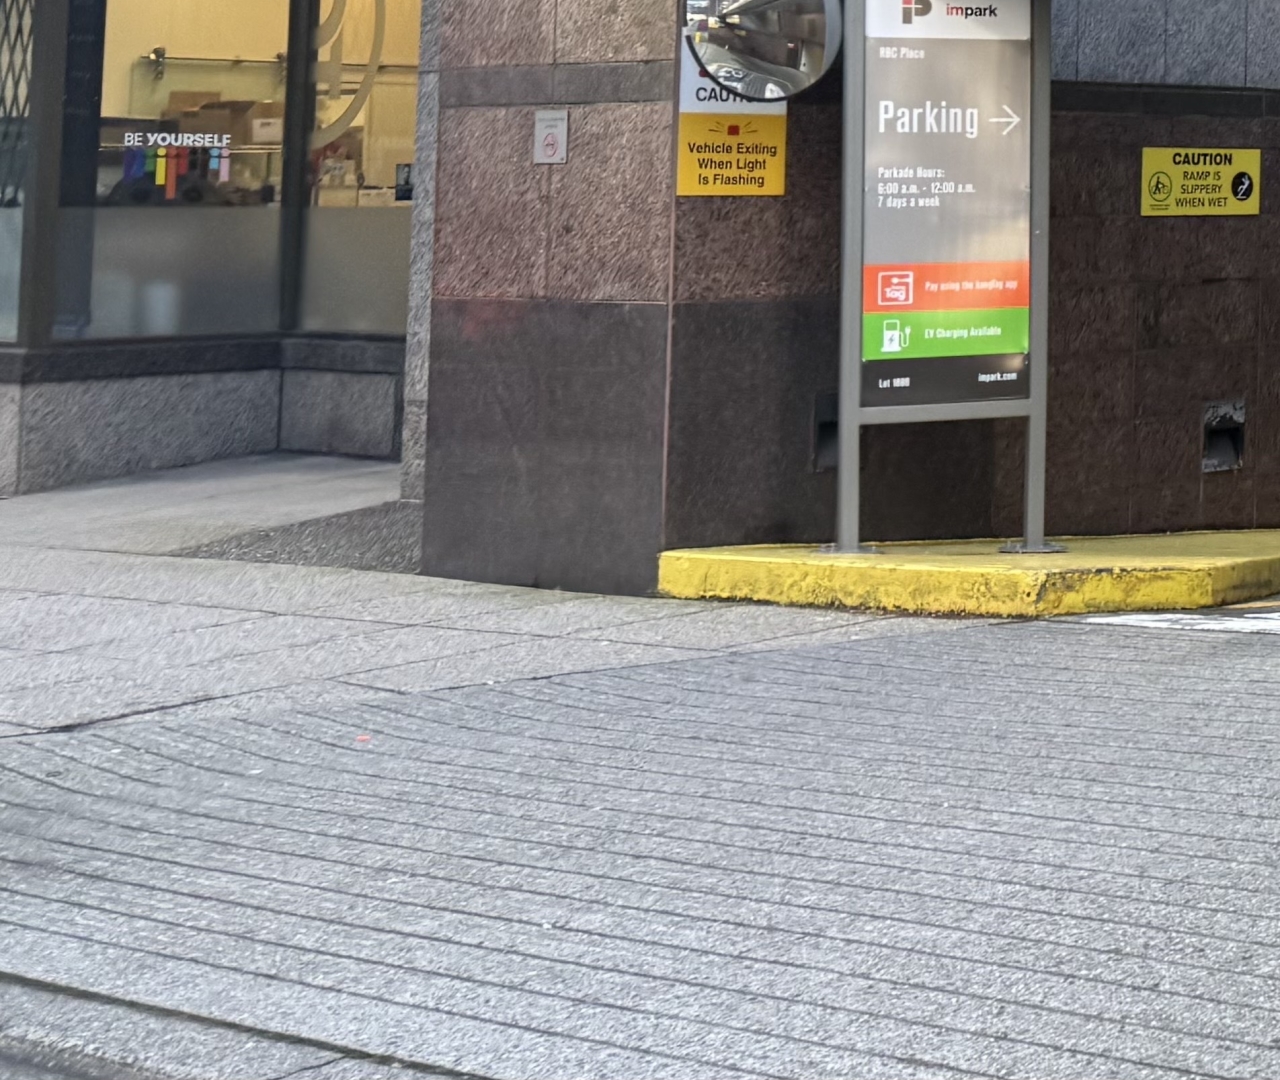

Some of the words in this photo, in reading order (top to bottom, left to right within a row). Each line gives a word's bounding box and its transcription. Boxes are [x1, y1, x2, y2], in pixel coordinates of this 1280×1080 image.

[946, 3, 997, 19] impark
[879, 47, 897, 59] RBC
[900, 47, 925, 59] Place
[878, 100, 979, 138] Parking
[124, 132, 143, 146] BE
[146, 132, 231, 146] YOURSELF
[688, 142, 732, 153] Vehicle
[737, 142, 777, 157] Exiting
[698, 158, 732, 170] When
[737, 158, 766, 172] Light
[1172, 152, 1233, 166] CAUTION
[878, 166, 914, 178] Parkade
[1183, 171, 1211, 180] RAMP
[1213, 171, 1221, 180] IS
[698, 174, 709, 185] Is
[713, 174, 765, 188] Flashing
[1180, 184, 1223, 194] SLIPPERY
[878, 196, 883, 207] 7
[886, 195, 907, 209] days
[910, 198, 915, 207] a
[918, 195, 940, 207] week
[1175, 197, 1205, 207] WHEN
[1207, 197, 1228, 207] WET
